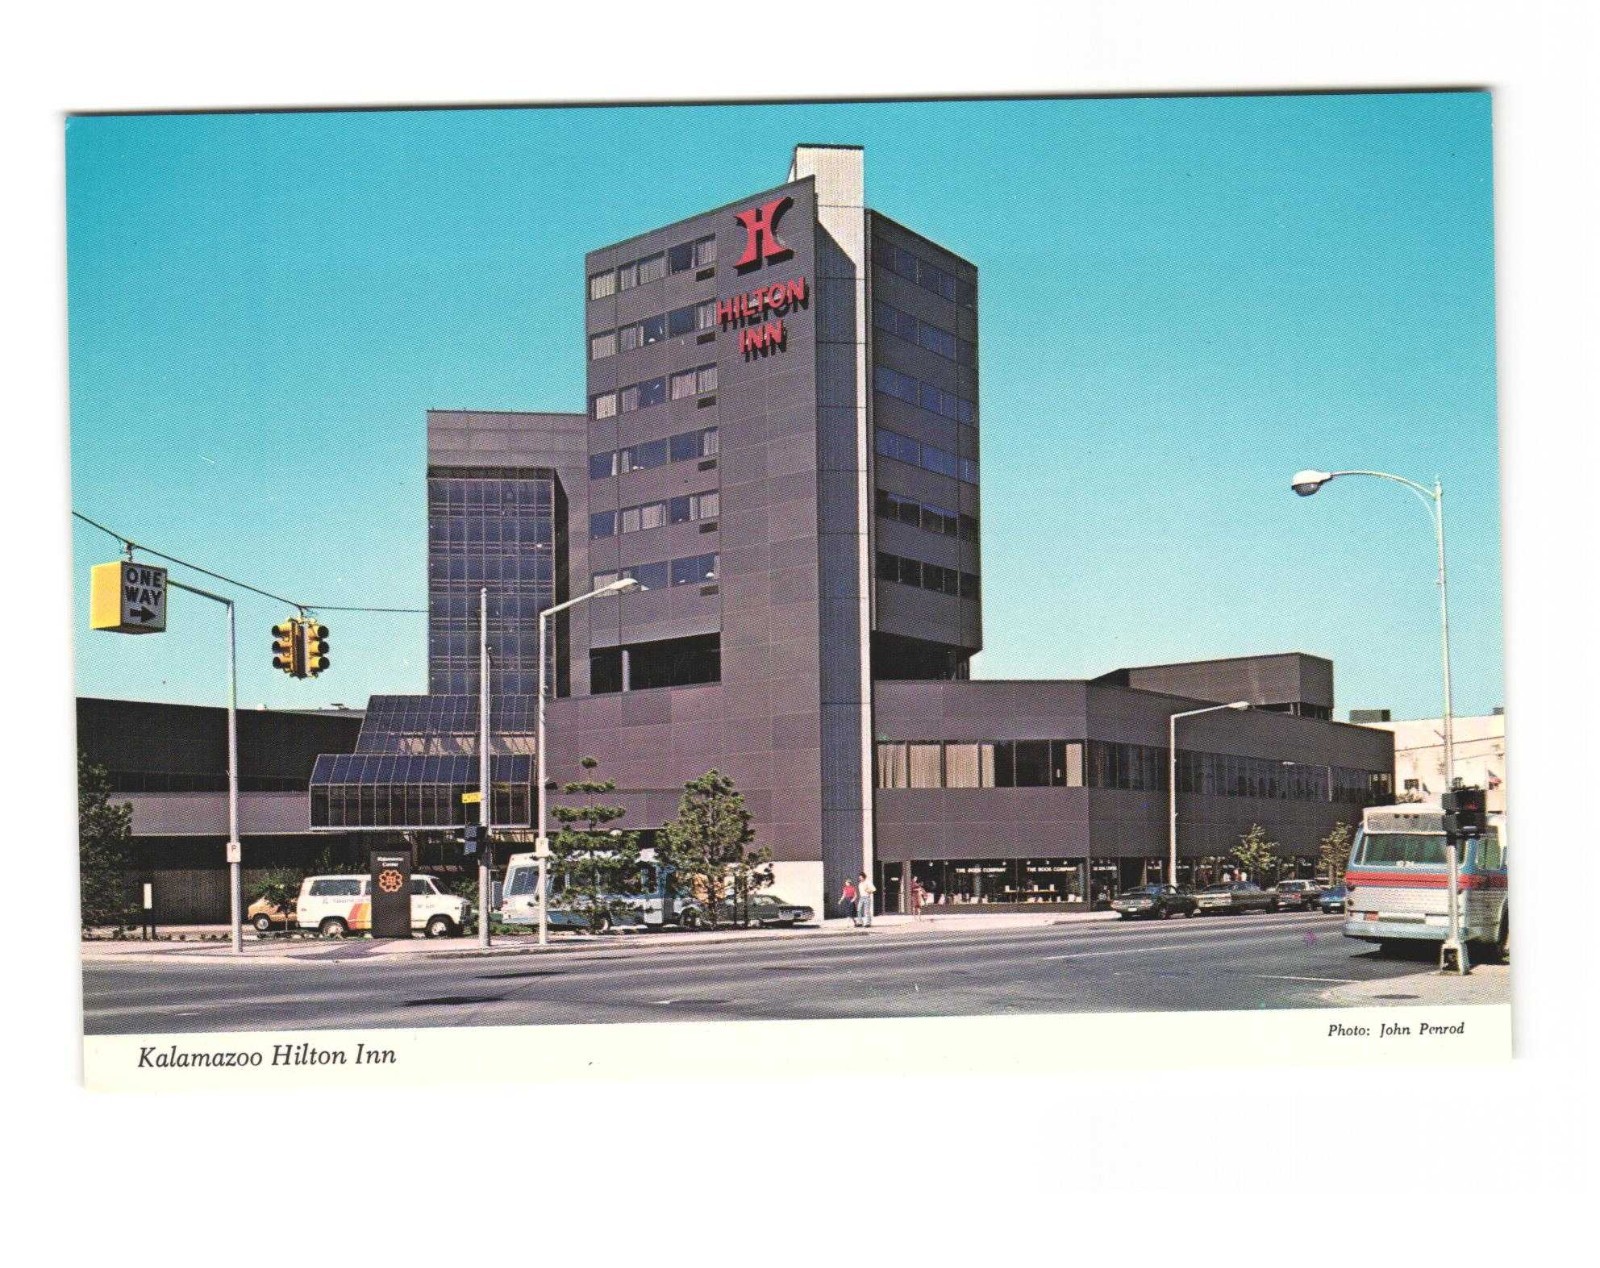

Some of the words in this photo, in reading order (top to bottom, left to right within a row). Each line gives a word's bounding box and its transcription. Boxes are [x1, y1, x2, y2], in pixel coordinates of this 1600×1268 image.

[716, 276, 808, 328] HILTON
[738, 319, 786, 359] INN
[126, 566, 163, 588] ONE
[124, 585, 163, 607] WAY
